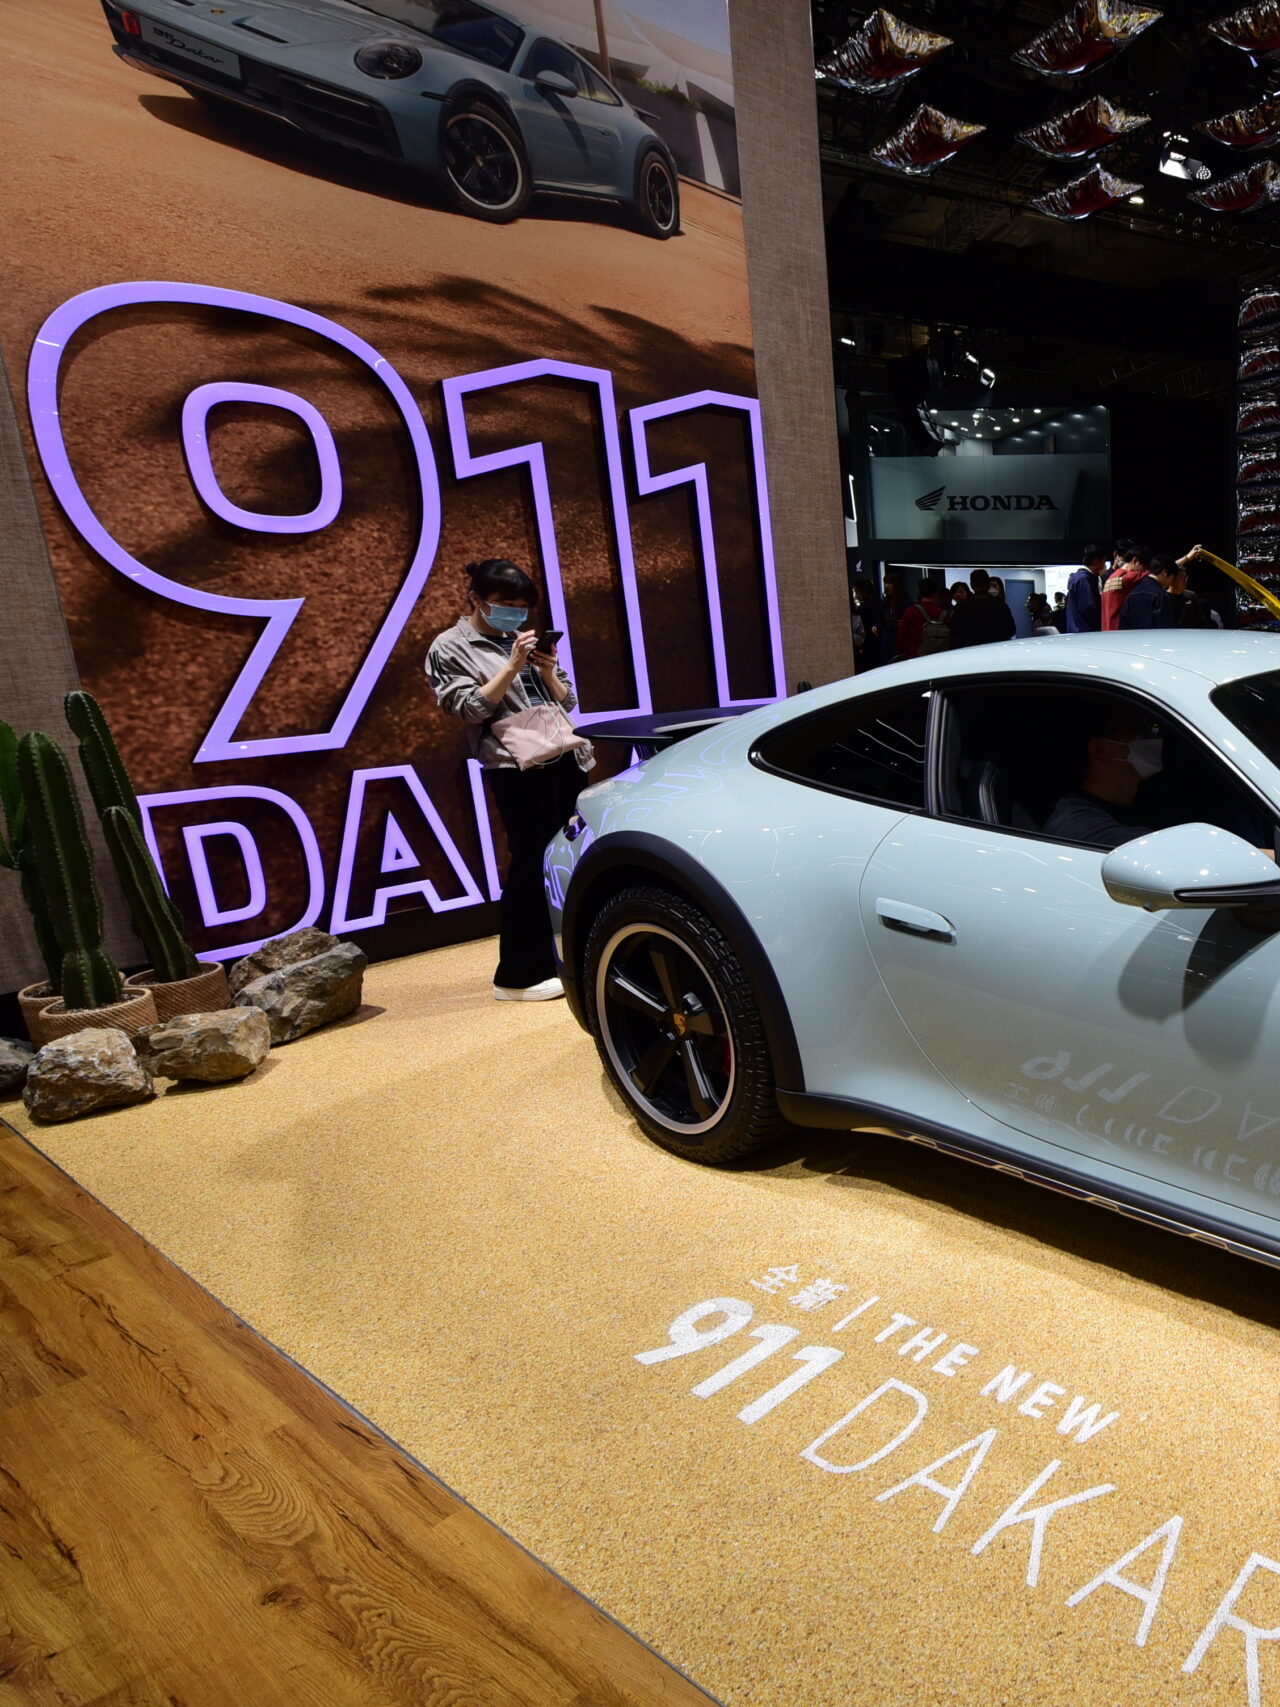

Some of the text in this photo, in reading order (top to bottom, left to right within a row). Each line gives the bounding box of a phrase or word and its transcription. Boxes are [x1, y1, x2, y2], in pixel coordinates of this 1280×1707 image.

[166, 38, 225, 65] Dakar
[27, 281, 787, 763] 911
[947, 494, 1058, 511] HONDA
[750, 1262, 847, 1311] 全新
[633, 1296, 845, 1425] 911
[874, 1312, 1121, 1443] THE NEW
